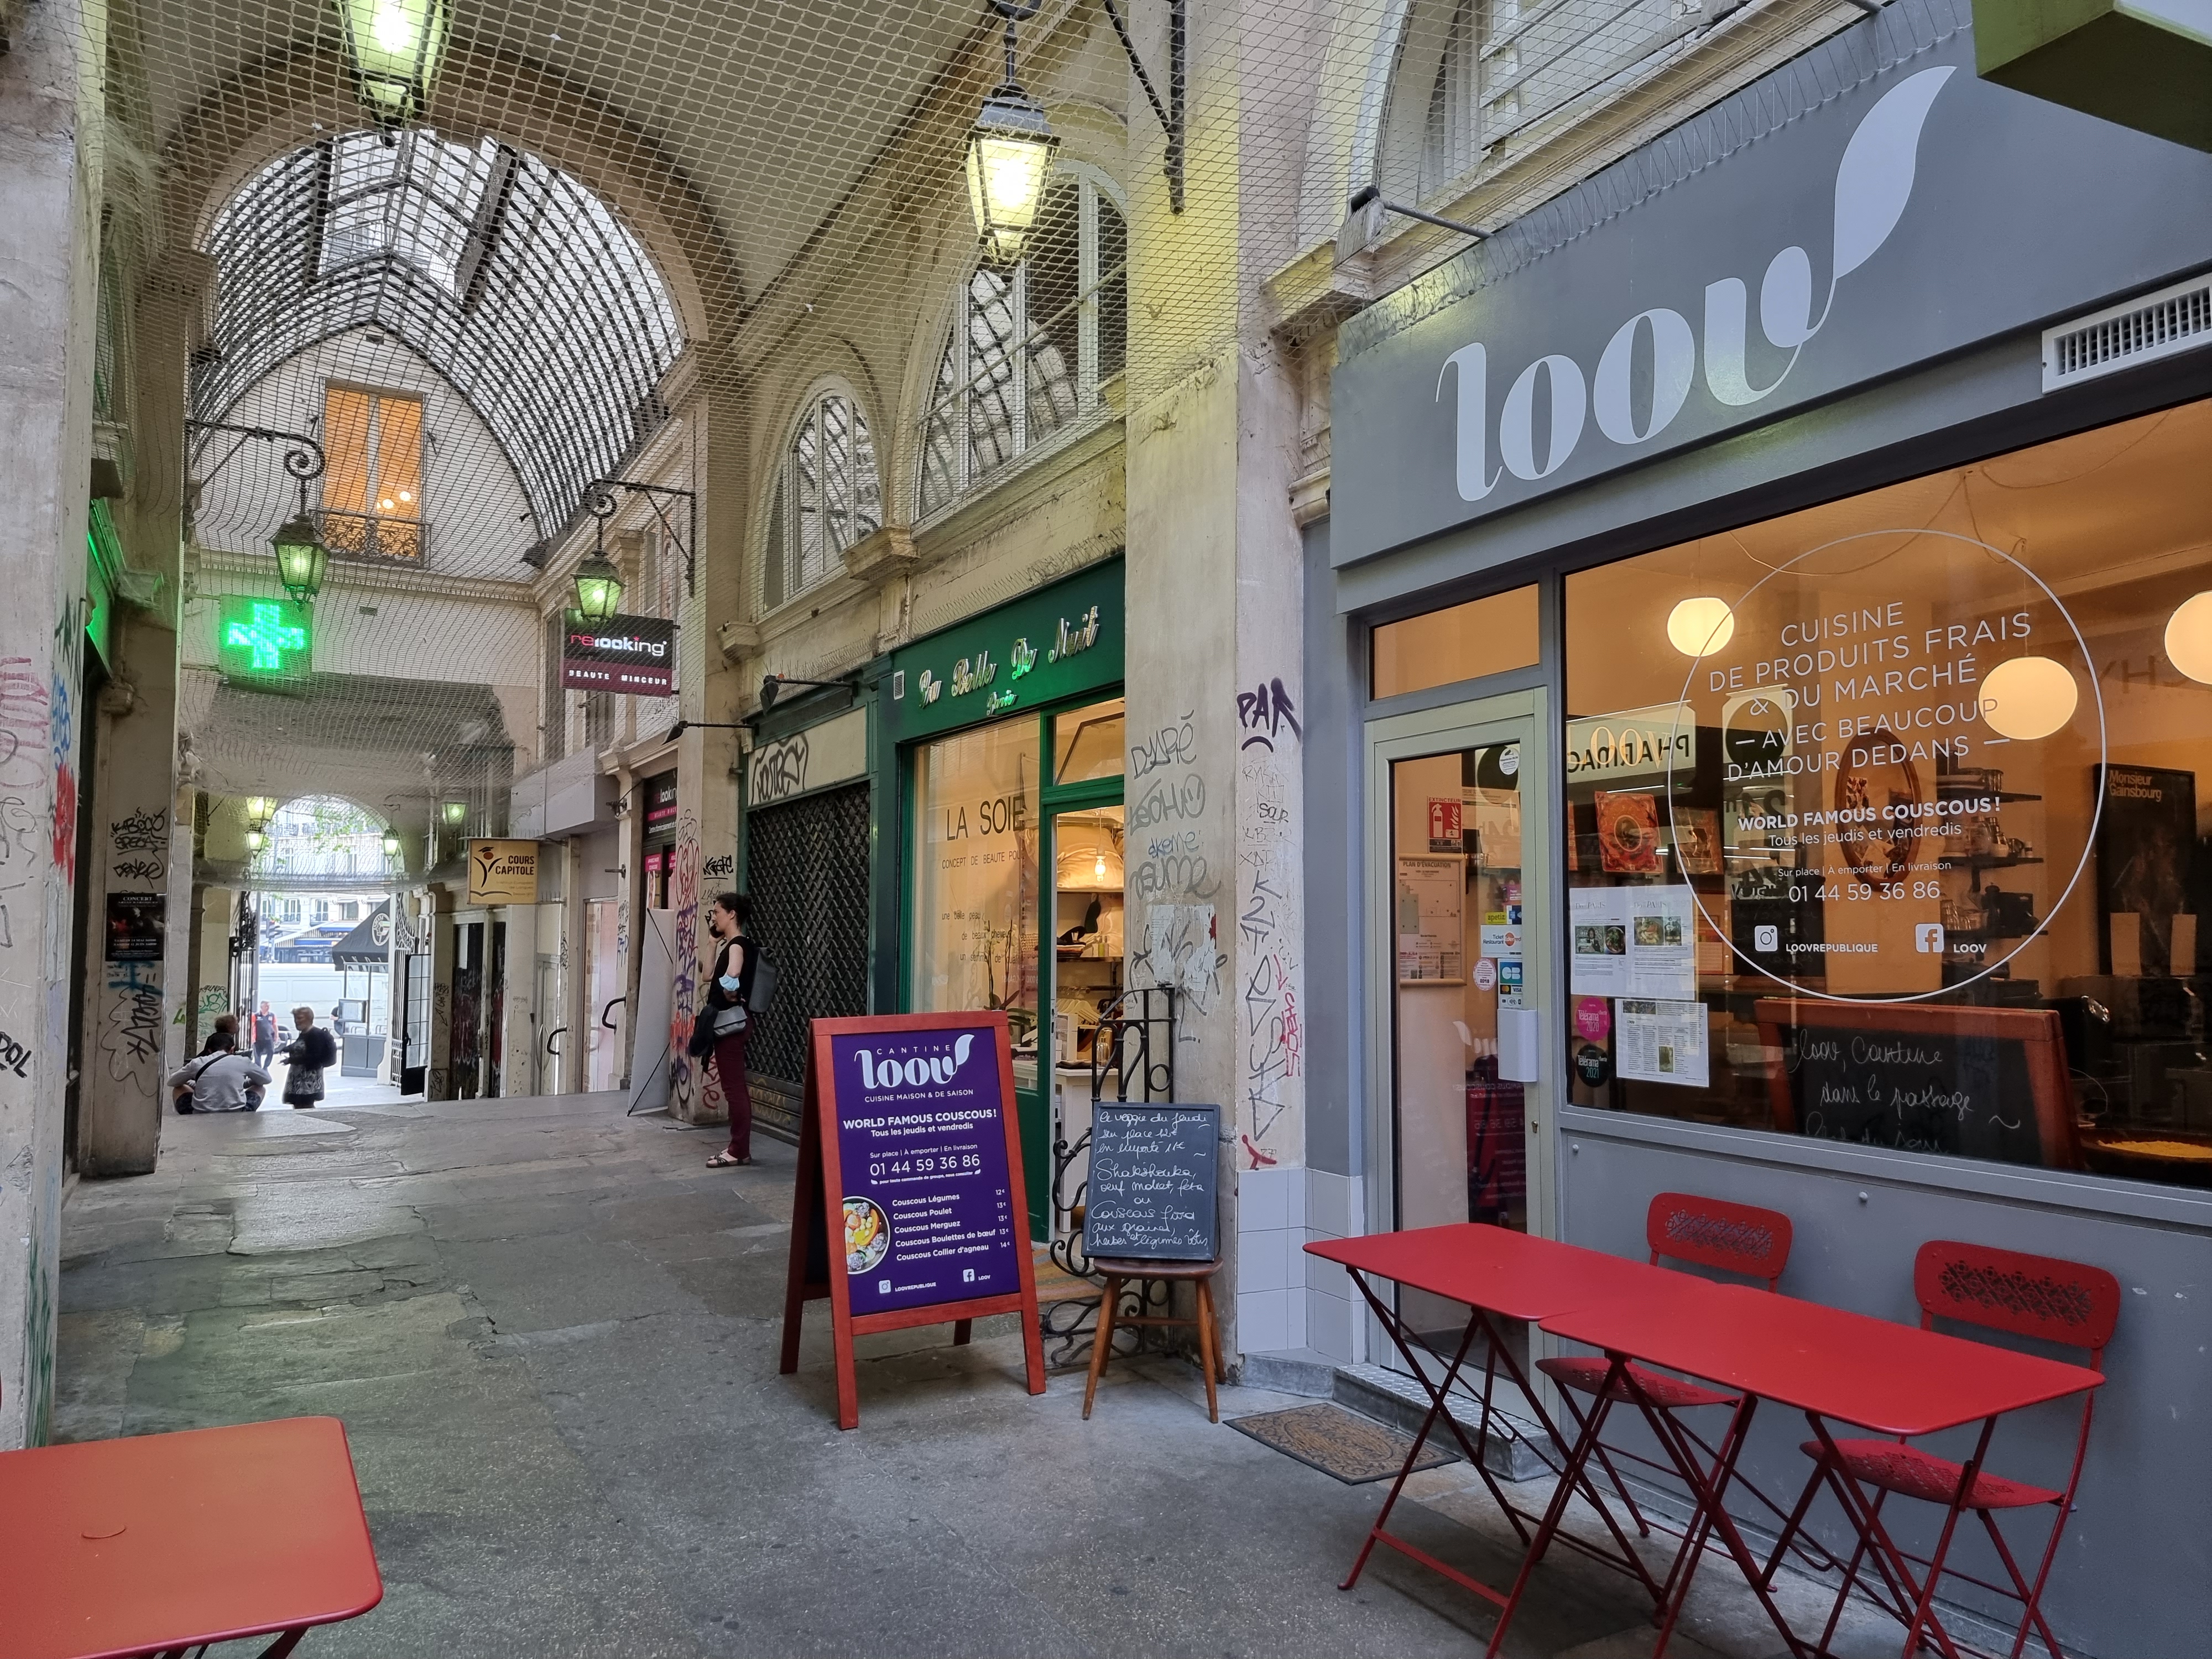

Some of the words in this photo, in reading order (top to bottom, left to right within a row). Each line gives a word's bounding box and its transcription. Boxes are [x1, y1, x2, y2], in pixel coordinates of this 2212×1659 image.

[1436, 65, 1958, 502] loov
[1781, 601, 1903, 647] CUISINE
[951, 650, 997, 697] Belle
[1047, 606, 1099, 664] Nuit
[1709, 666, 1744, 692] DE
[1756, 635, 1910, 684] PRODUITS
[1926, 613, 2032, 654] FRAIS
[568, 670, 610, 680] BEAUTE
[621, 674, 667, 685] MINCEUR
[1749, 693, 1769, 716] &
[1784, 684, 1820, 709] DU
[1835, 653, 1977, 703] MARCHÉ
[986, 690, 1017, 716] Paris
[1762, 722, 1827, 748] AVEC
[1839, 698, 1999, 739] BEAUCOUP
[1728, 752, 1840, 782] D'AMOUR
[1851, 735, 1970, 768] DEDANS
[2109, 770, 2152, 786] Monsieur
[2109, 784, 2162, 802] Gainsbourg
[947, 806, 968, 841] LA
[980, 796, 1025, 835] SOIE
[1738, 814, 1798, 831] WORLD
[1803, 807, 1876, 825] FAMOUS
[1768, 834, 1798, 847] Tous
[1802, 832, 1820, 845] les
[1823, 827, 1864, 846] jeudis
[1869, 827, 1882, 840] et
[1887, 822, 1962, 839] vendredis
[508, 855, 534, 864] COURS
[942, 857, 966, 869] CONCEPT
[971, 855, 978, 865] DE
[983, 852, 1005, 864] BEAUTE
[495, 865, 534, 875] CAPITOLE
[1777, 868, 1793, 878] Sur
[1795, 867, 1820, 878] place
[1837, 864, 1882, 877] emporter
[1892, 862, 1905, 872] En
[1907, 860, 1952, 872] livraison
[1788, 885, 1808, 902] 01
[1814, 884, 1840, 901] 44
[1847, 883, 1872, 901] 59
[1879, 881, 1906, 900] 36
[1912, 880, 1940, 899] 86
[969, 912, 981, 921] peau
[962, 931, 968, 940] de
[972, 931, 987, 940] beaux
[1786, 943, 1879, 954] LOOVREPUBLIQUE
[1953, 943, 1987, 953] LOOV
[994, 953, 1001, 963] de
[1502, 967, 1521, 979] CB
[1578, 1009, 1599, 1021] Télérama
[1587, 1021, 1599, 1031] 2020
[877, 1045, 951, 1055] CANTINE
[854, 1034, 975, 1089] loov
[1578, 1055, 1599, 1068] Télérama
[1586, 1067, 1599, 1078] 2021
[865, 1094, 894, 1103] CUISINE
[1820, 1081, 1861, 1107] dans
[1867, 1074, 1881, 1102] le
[1890, 1085, 1974, 1120] passage
[843, 1118, 885, 1129] WORLD
[888, 1114, 932, 1126] FAMOUS
[935, 1108, 997, 1123] COUSCOUS!
[1114, 1113, 1147, 1127] veggie
[1150, 1112, 1168, 1122] du
[871, 1129, 889, 1137] Tous
[890, 1127, 902, 1136] les
[903, 1125, 926, 1135] jeudis
[937, 1121, 973, 1131] vendredis
[1121, 1129, 1153, 1145] place
[911, 1147, 939, 1156] emporter
[1096, 1143, 1114, 1154] en
[870, 1163, 885, 1176] 01
[891, 1161, 911, 1173] 44
[916, 1159, 934, 1171] 59
[940, 1156, 957, 1169] 36
[962, 1154, 980, 1167] 86
[1177, 1178, 1204, 1197] feta
[892, 1197, 927, 1207] Couscous
[928, 1194, 960, 1203] Légumes
[1134, 1196, 1152, 1204] ou
[893, 1211, 928, 1220] Couscous
[929, 1207, 952, 1216] Poulet
[1091, 1200, 1156, 1219] Couscous
[894, 1224, 929, 1234] Couscous
[930, 1220, 961, 1230] Merguez
[1092, 1222, 1115, 1233] aux
[895, 1238, 930, 1248] Couscous
[931, 1233, 965, 1243] Boulettes
[977, 1229, 996, 1238] bœuf
[896, 1251, 931, 1261] Couscous
[932, 1248, 956, 1257] Collier
[957, 1244, 989, 1254] d'agneau
[895, 1282, 937, 1292] LOOVREPUBLIQUE
